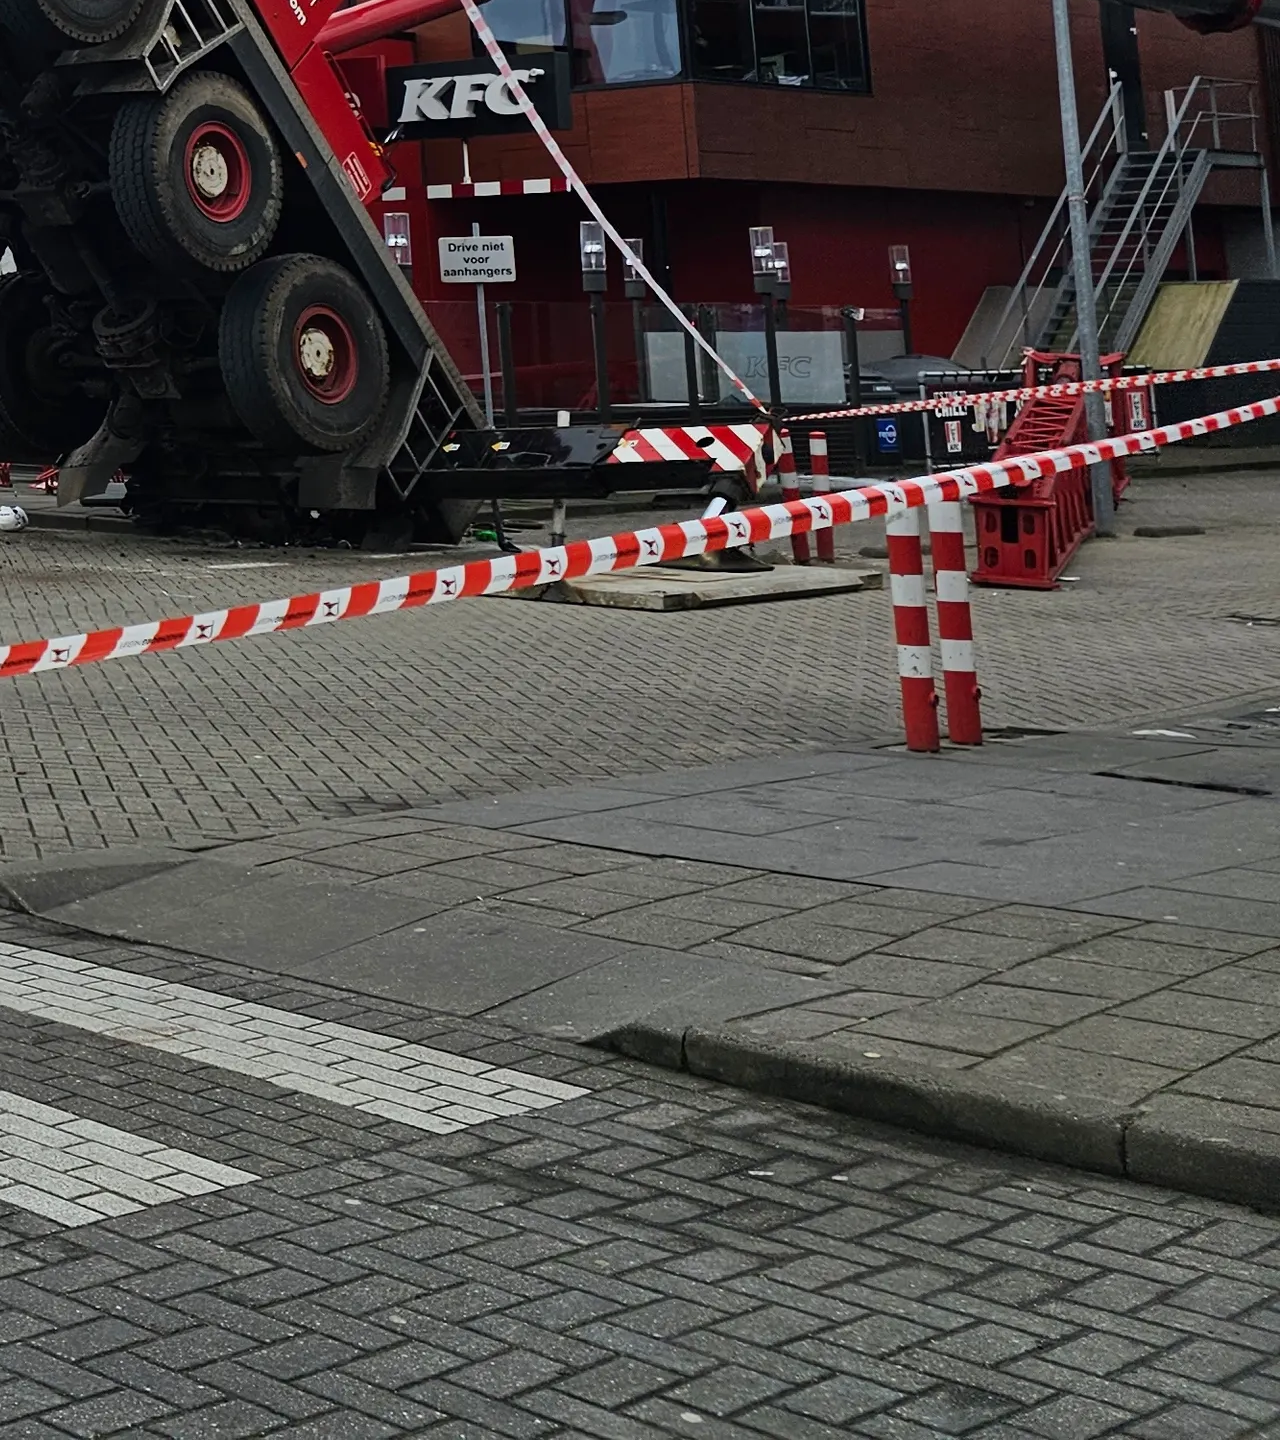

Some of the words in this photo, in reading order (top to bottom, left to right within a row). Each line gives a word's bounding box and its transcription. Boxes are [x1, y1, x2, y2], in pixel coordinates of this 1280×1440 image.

[396, 68, 538, 123] KFC
[447, 242, 479, 253] Drive
[481, 241, 505, 252] niet
[462, 255, 491, 265] voor
[443, 266, 513, 278] aanhangers
